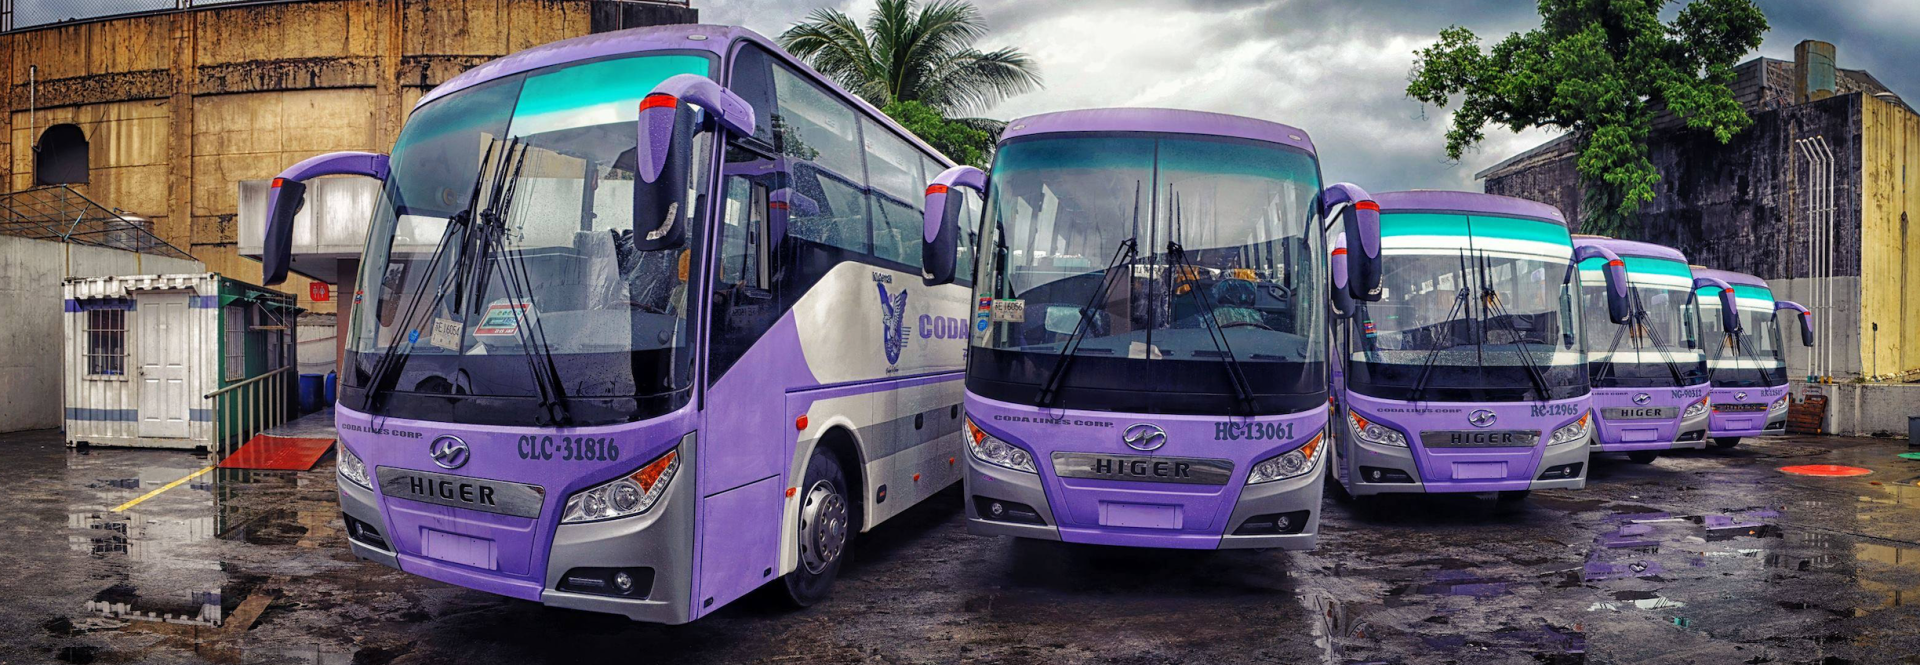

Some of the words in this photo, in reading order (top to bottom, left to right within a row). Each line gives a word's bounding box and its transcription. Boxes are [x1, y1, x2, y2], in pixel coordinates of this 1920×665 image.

[918, 313, 969, 340] CODA
[1530, 403, 1579, 417] RC-12965
[1621, 408, 1662, 417] HIGER
[994, 414, 1030, 423] CODA
[1033, 417, 1071, 426] LINES
[1074, 420, 1115, 428] CORP.
[341, 423, 362, 432] CODA
[363, 426, 390, 435] LINES
[391, 429, 424, 439] CORP.
[1214, 421, 1295, 442] HC-13061
[1451, 432, 1513, 445] HIGER
[517, 435, 620, 462] CLC-31816
[1095, 458, 1192, 478] HIGER
[409, 475, 497, 506] HIGER
